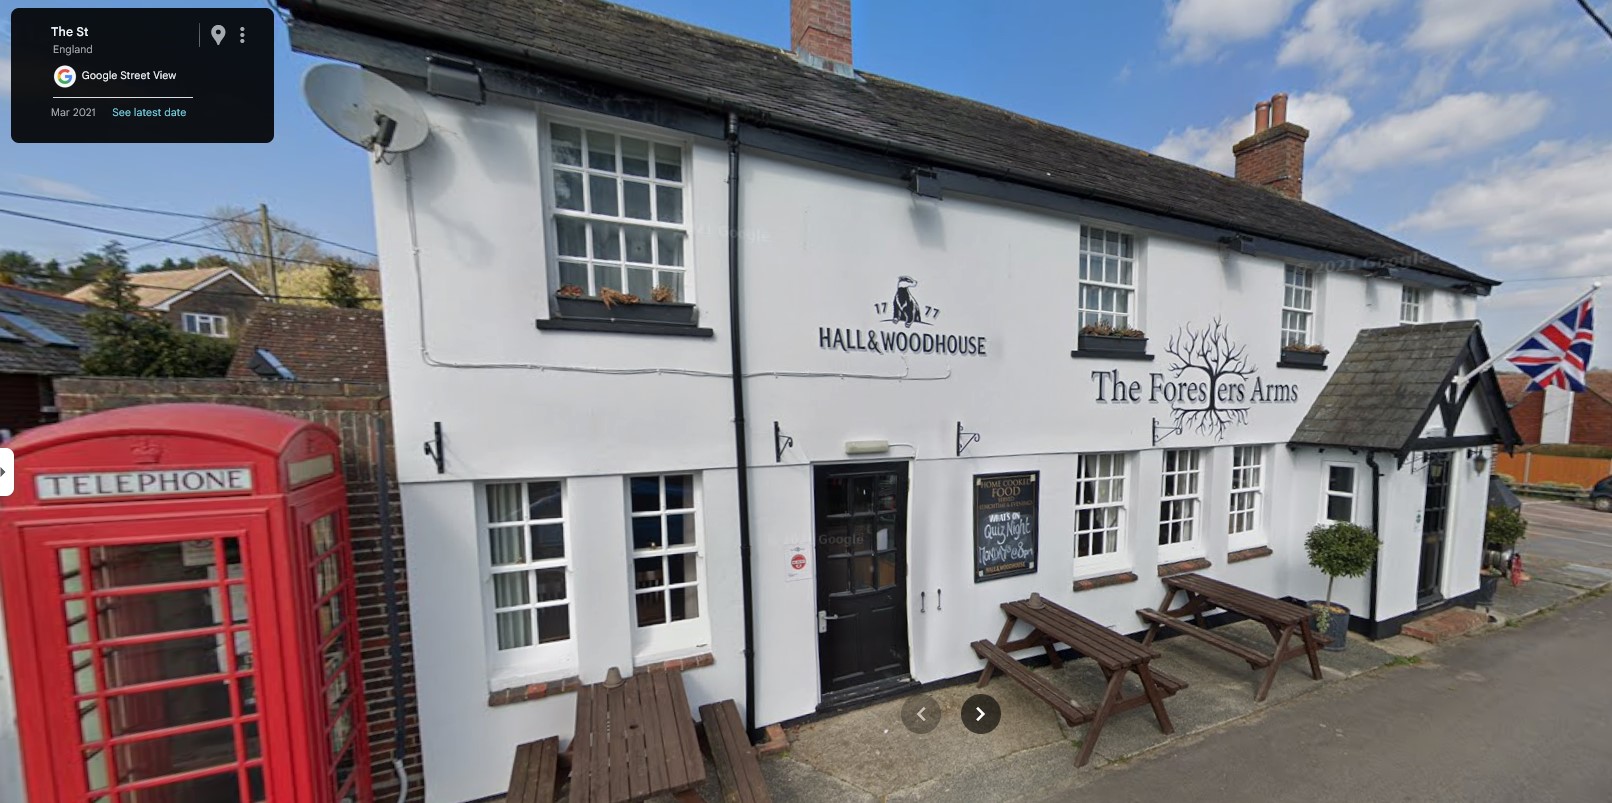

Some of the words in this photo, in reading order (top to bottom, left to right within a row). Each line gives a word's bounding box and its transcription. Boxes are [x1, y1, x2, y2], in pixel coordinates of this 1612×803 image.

[874, 302, 888, 315] 17
[924, 305, 940, 319] 77
[1091, 368, 1142, 403] The
[1250, 376, 1299, 403] Arms
[43, 469, 244, 497] TELEPHONE
[980, 479, 1001, 489] HOME
[1002, 477, 1032, 487] COOKED
[991, 486, 1021, 498] FOOD
[984, 523, 1006, 545] Quiz
[1006, 516, 1031, 540] Night
